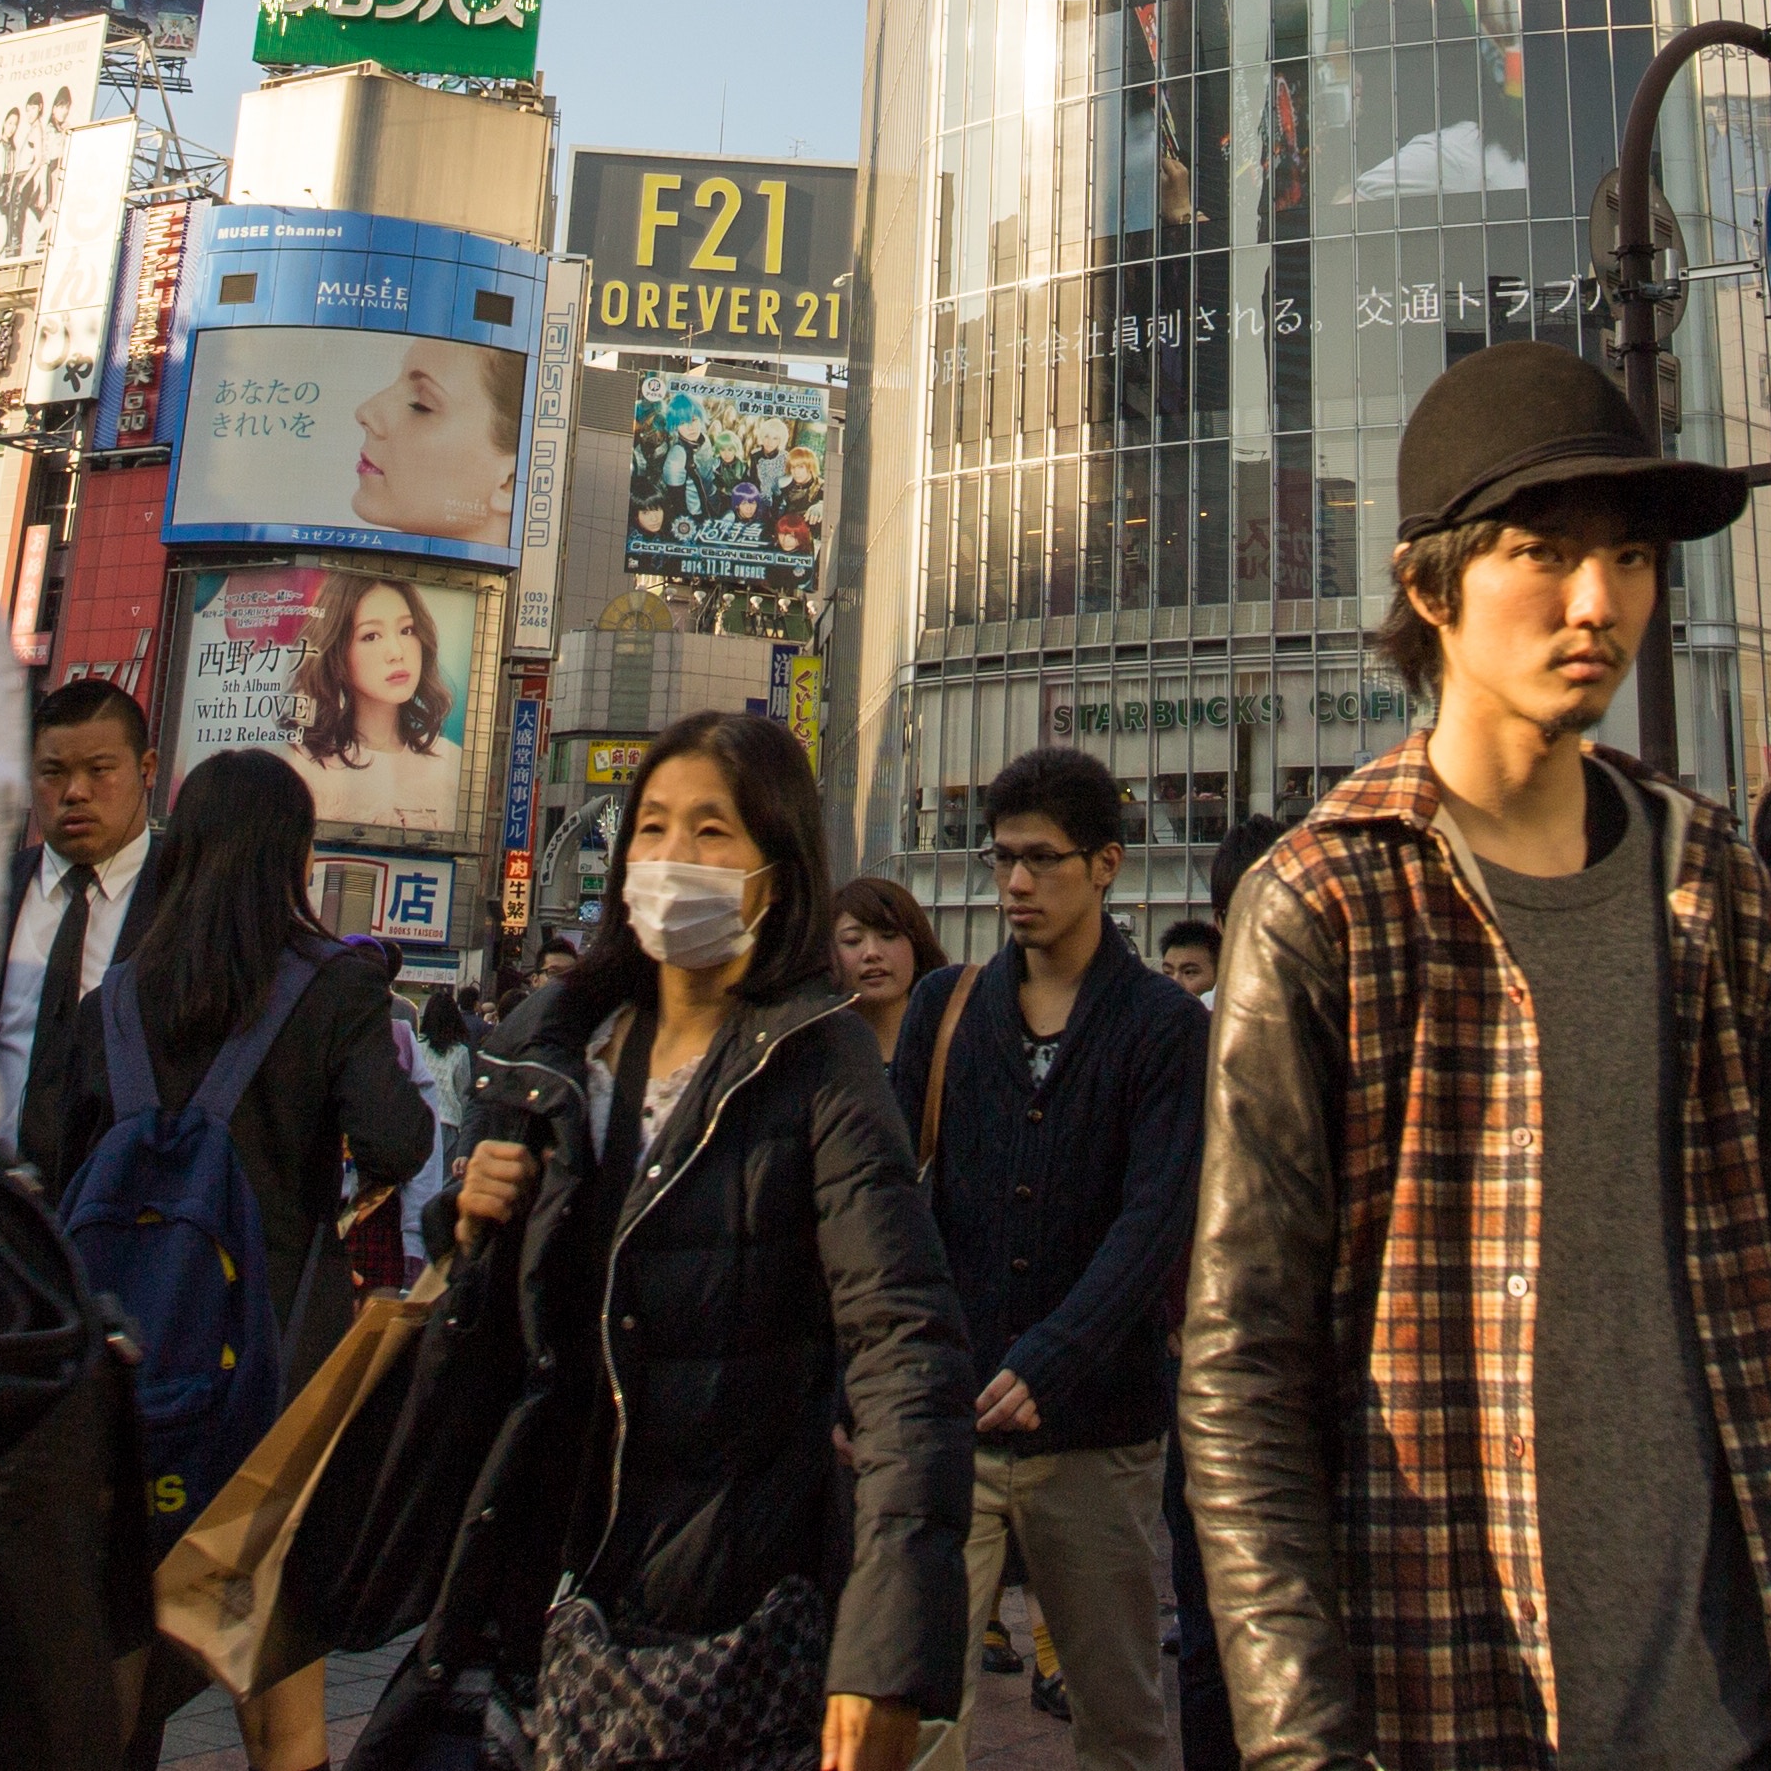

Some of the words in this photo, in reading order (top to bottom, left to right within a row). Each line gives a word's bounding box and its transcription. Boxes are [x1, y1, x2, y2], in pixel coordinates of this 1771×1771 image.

[8, 59, 74, 82] message
[217, 224, 270, 240] MUSEE
[274, 224, 343, 238] Channel
[635, 172, 788, 276] F21
[316, 295, 409, 312] PLATINUM
[794, 289, 843, 340] 21
[214, 379, 320, 405] あなたの
[738, 401, 821, 421] 僕が歯車になる
[211, 412, 316, 440] きれいを
[527, 440, 557, 548] neon
[290, 528, 383, 547] ミュゼプラチナム
[631, 542, 665, 553] Star
[665, 544, 698, 555] Gear
[681, 559, 732, 575] 2014.11.12
[524, 591, 548, 603] (03)
[520, 604, 549, 616] 3719
[519, 616, 548, 628] 2468
[197, 637, 319, 678] 西野カナ
[221, 679, 241, 694] 5th
[242, 678, 282, 694] Album
[1052, 692, 1285, 735] STARBUCKS
[196, 727, 233, 743] 11.12
[235, 726, 304, 744] Release!
[506, 708, 535, 841] 大盛堂商事ビル
[387, 871, 439, 925] 店
[507, 880, 527, 920] 牛繁
[388, 925, 412, 937] BOOKS
[413, 927, 444, 939] TAISEIDO
